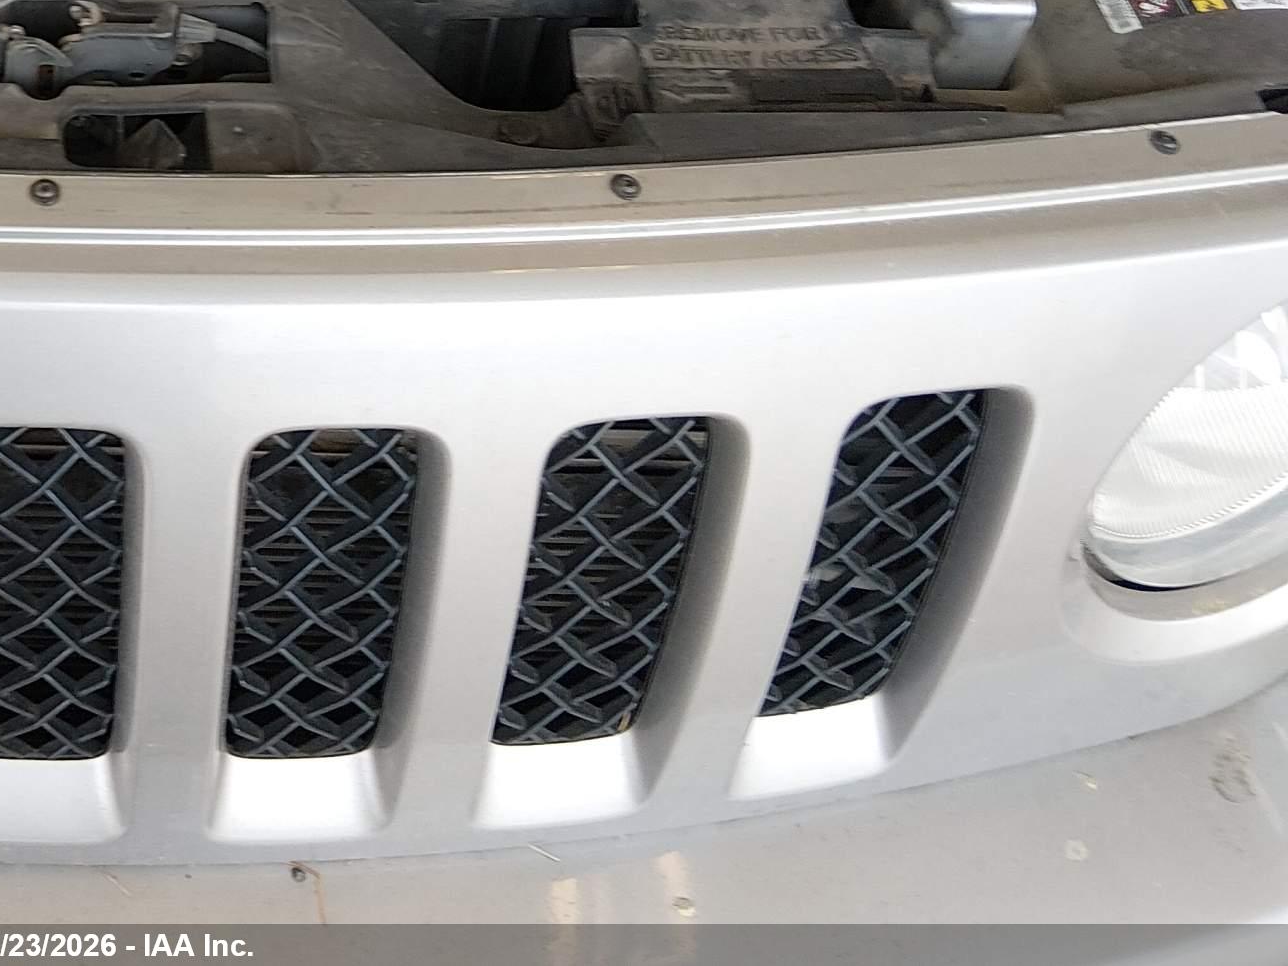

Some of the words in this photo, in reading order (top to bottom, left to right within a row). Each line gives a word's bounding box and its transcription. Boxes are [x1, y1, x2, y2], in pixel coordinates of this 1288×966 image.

[657, 24, 761, 43] REMOVE
[769, 25, 824, 43] FOR
[651, 44, 753, 66] BATTERY
[762, 46, 858, 66] ACCESS
